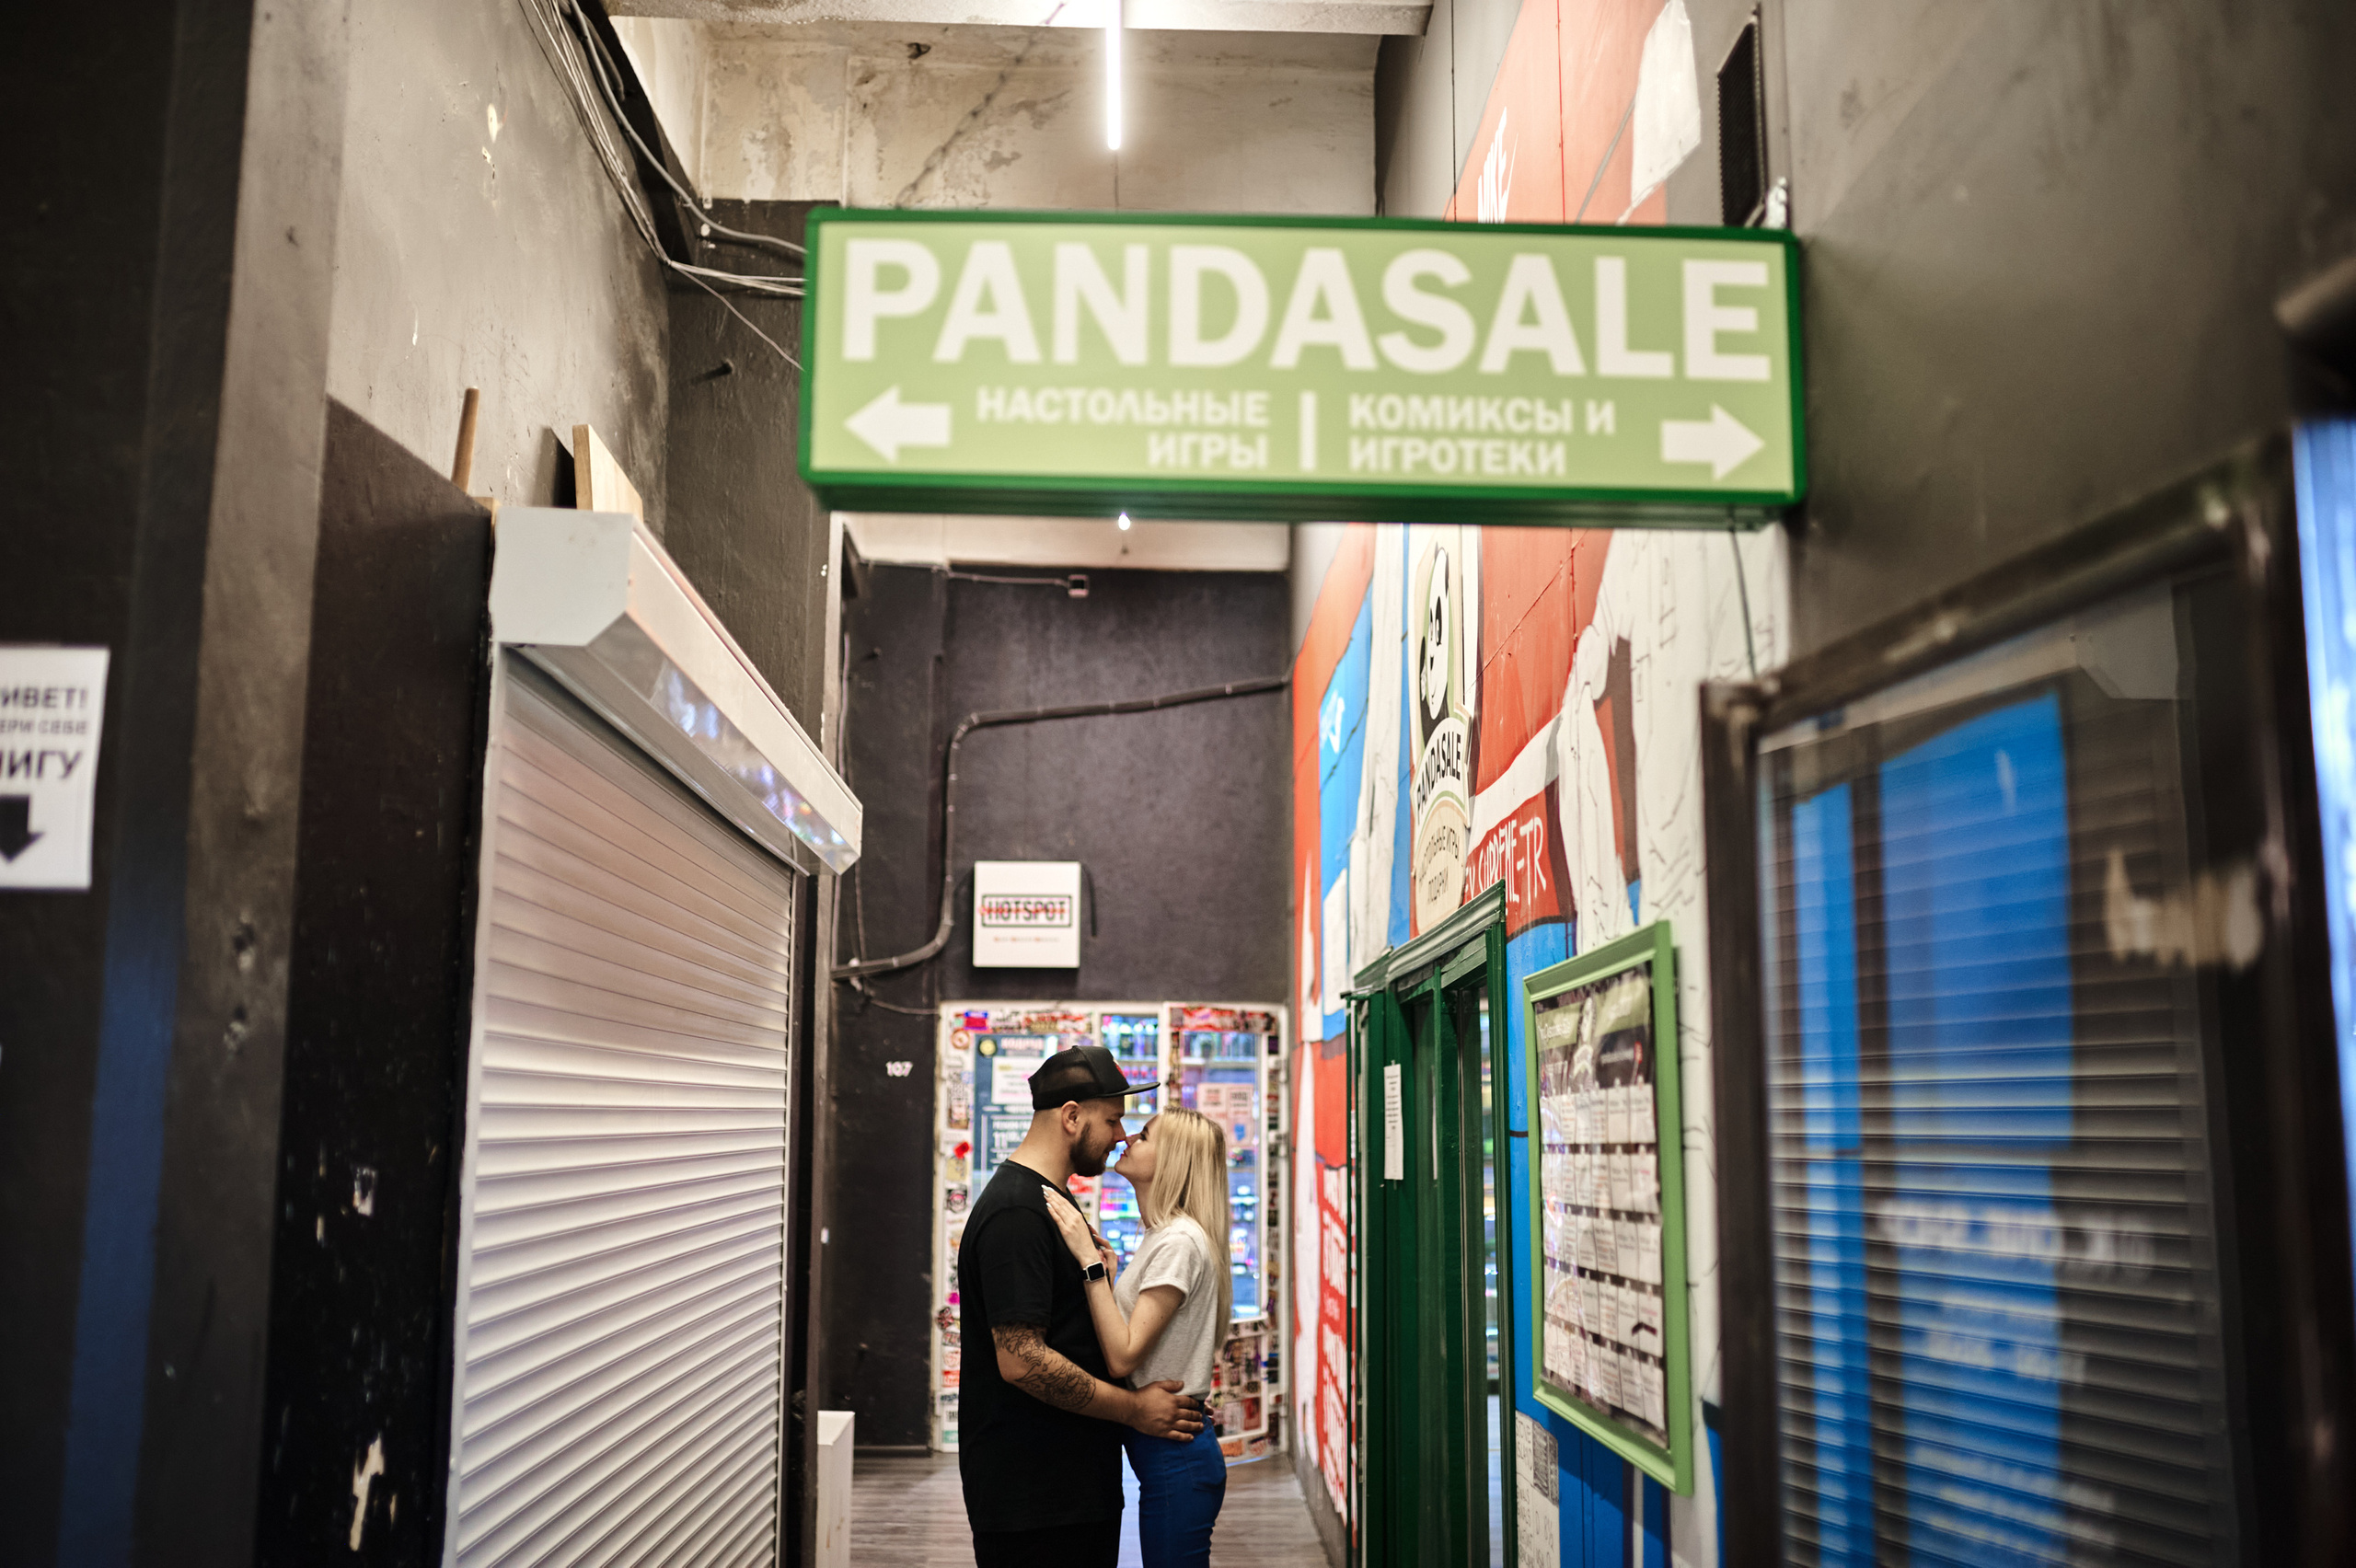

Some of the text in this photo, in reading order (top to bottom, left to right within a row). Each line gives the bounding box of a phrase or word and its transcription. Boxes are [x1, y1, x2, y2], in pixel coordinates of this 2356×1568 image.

[842, 237, 1773, 381] PANDASALE
[976, 386, 1270, 427] НАСТОЛЬНЫЕ
[1349, 393, 1616, 435] КОМИКСЫ И
[1148, 432, 1268, 470] ИГРЫ
[1349, 437, 1565, 476] ИГРОТЕКИ
[0, 749, 83, 779] ИГУ
[1416, 732, 1461, 826] PANDASALE
[987, 900, 1066, 921] HOTSPOT
[885, 1061, 914, 1078] 107
